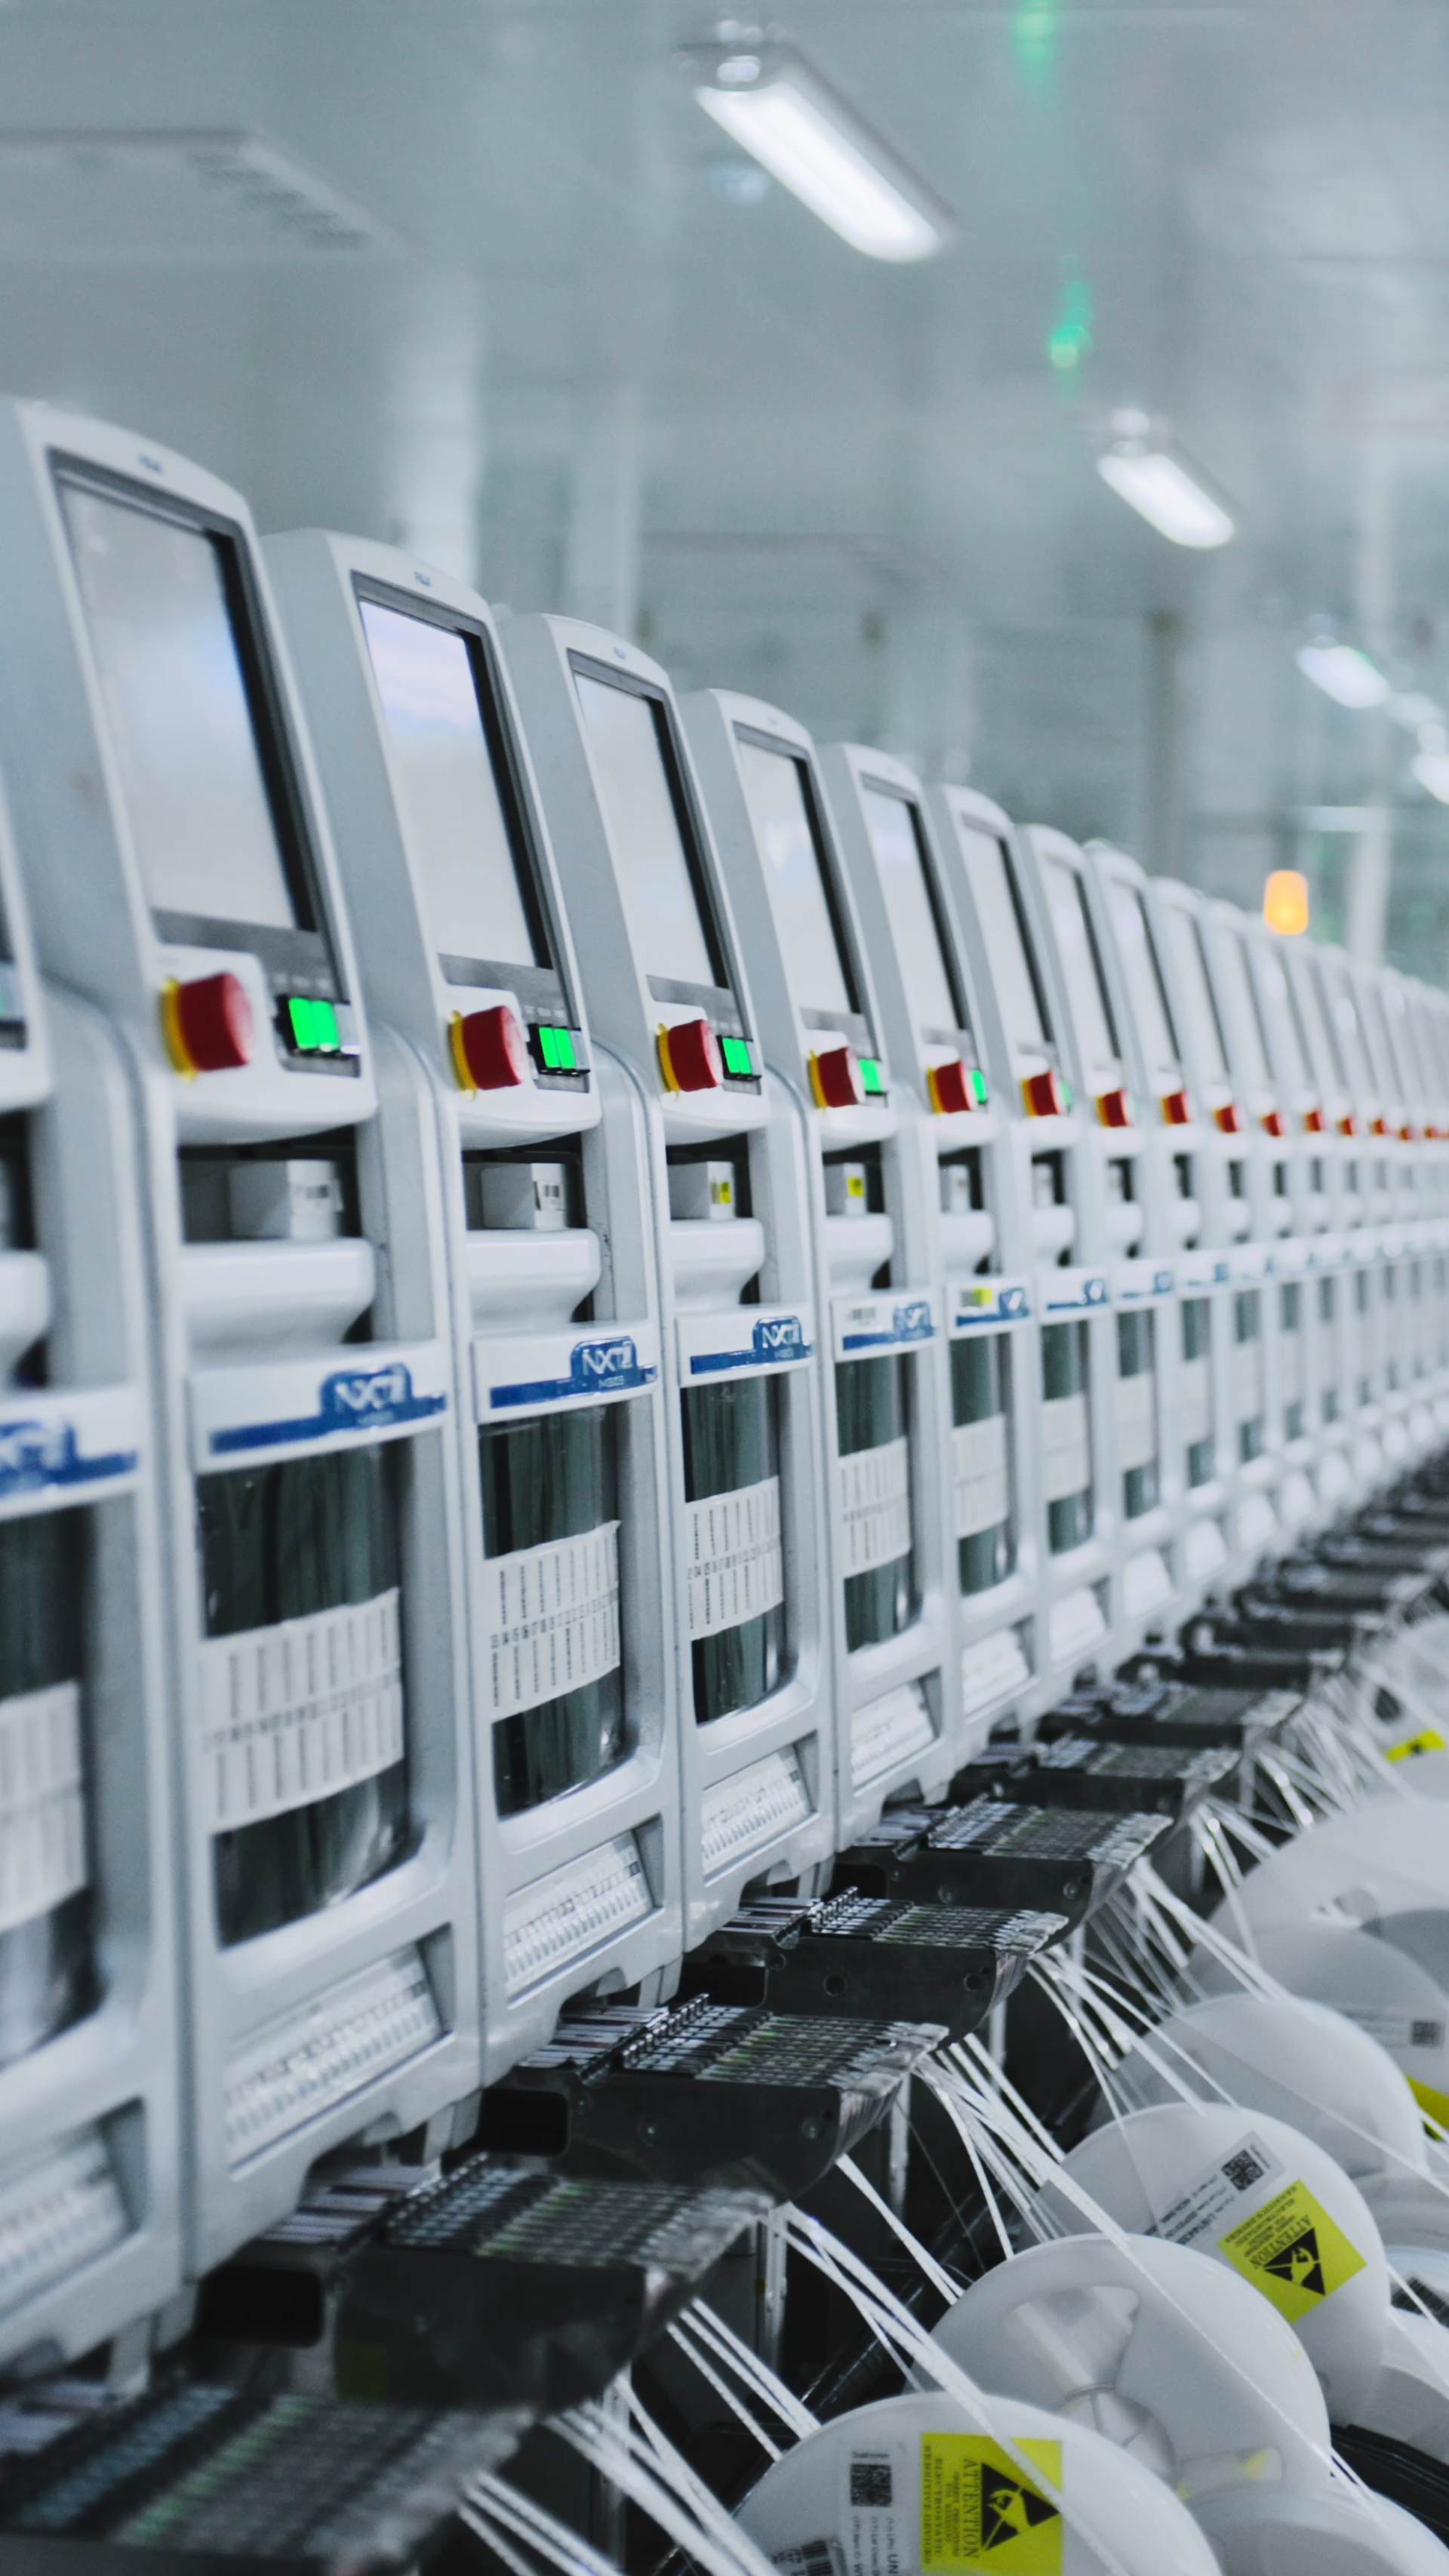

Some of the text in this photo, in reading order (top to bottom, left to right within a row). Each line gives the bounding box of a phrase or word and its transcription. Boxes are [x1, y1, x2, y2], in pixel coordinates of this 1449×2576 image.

[1248, 2214, 1313, 2270] ATTENTION
[934, 2458, 943, 2557] ELECTROSTATIC
[963, 2458, 980, 2559] ATTENTION
